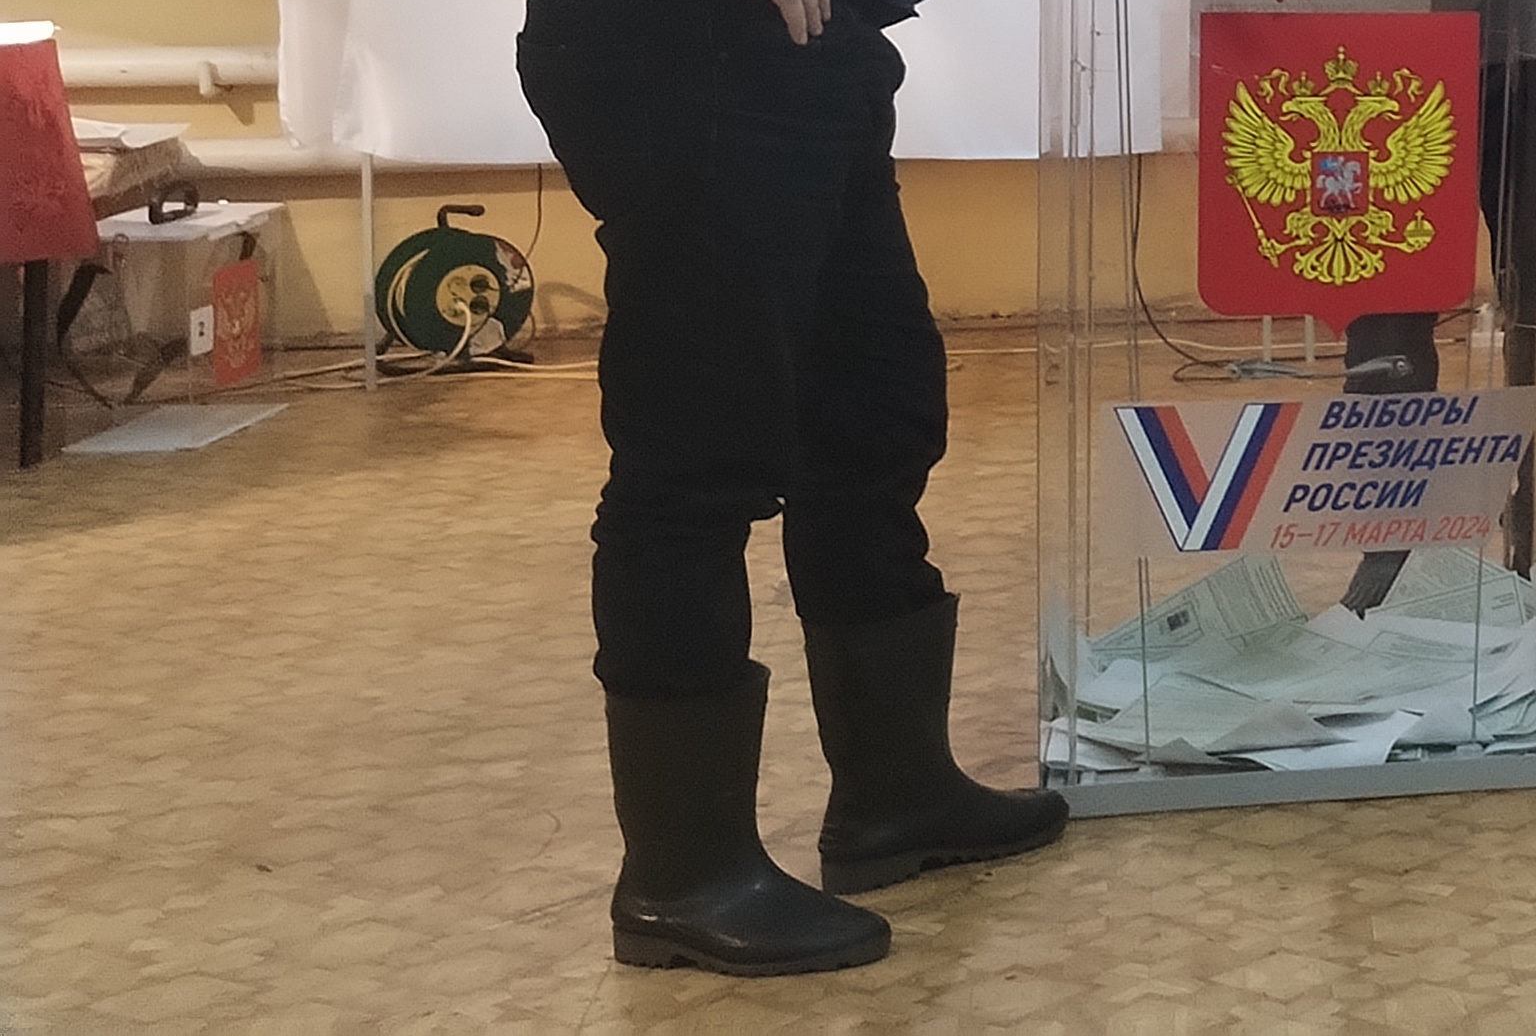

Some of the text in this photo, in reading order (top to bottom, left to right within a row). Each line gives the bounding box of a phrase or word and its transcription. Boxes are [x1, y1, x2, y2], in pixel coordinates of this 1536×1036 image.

[1320, 395, 1479, 431] ВЫБОРЫ
[1301, 434, 1524, 472] ПРЕЗИДЕНТА
[1283, 478, 1428, 513] РОССИИ
[1342, 517, 1428, 547] МАРТА
[1431, 515, 1492, 542] 2024
